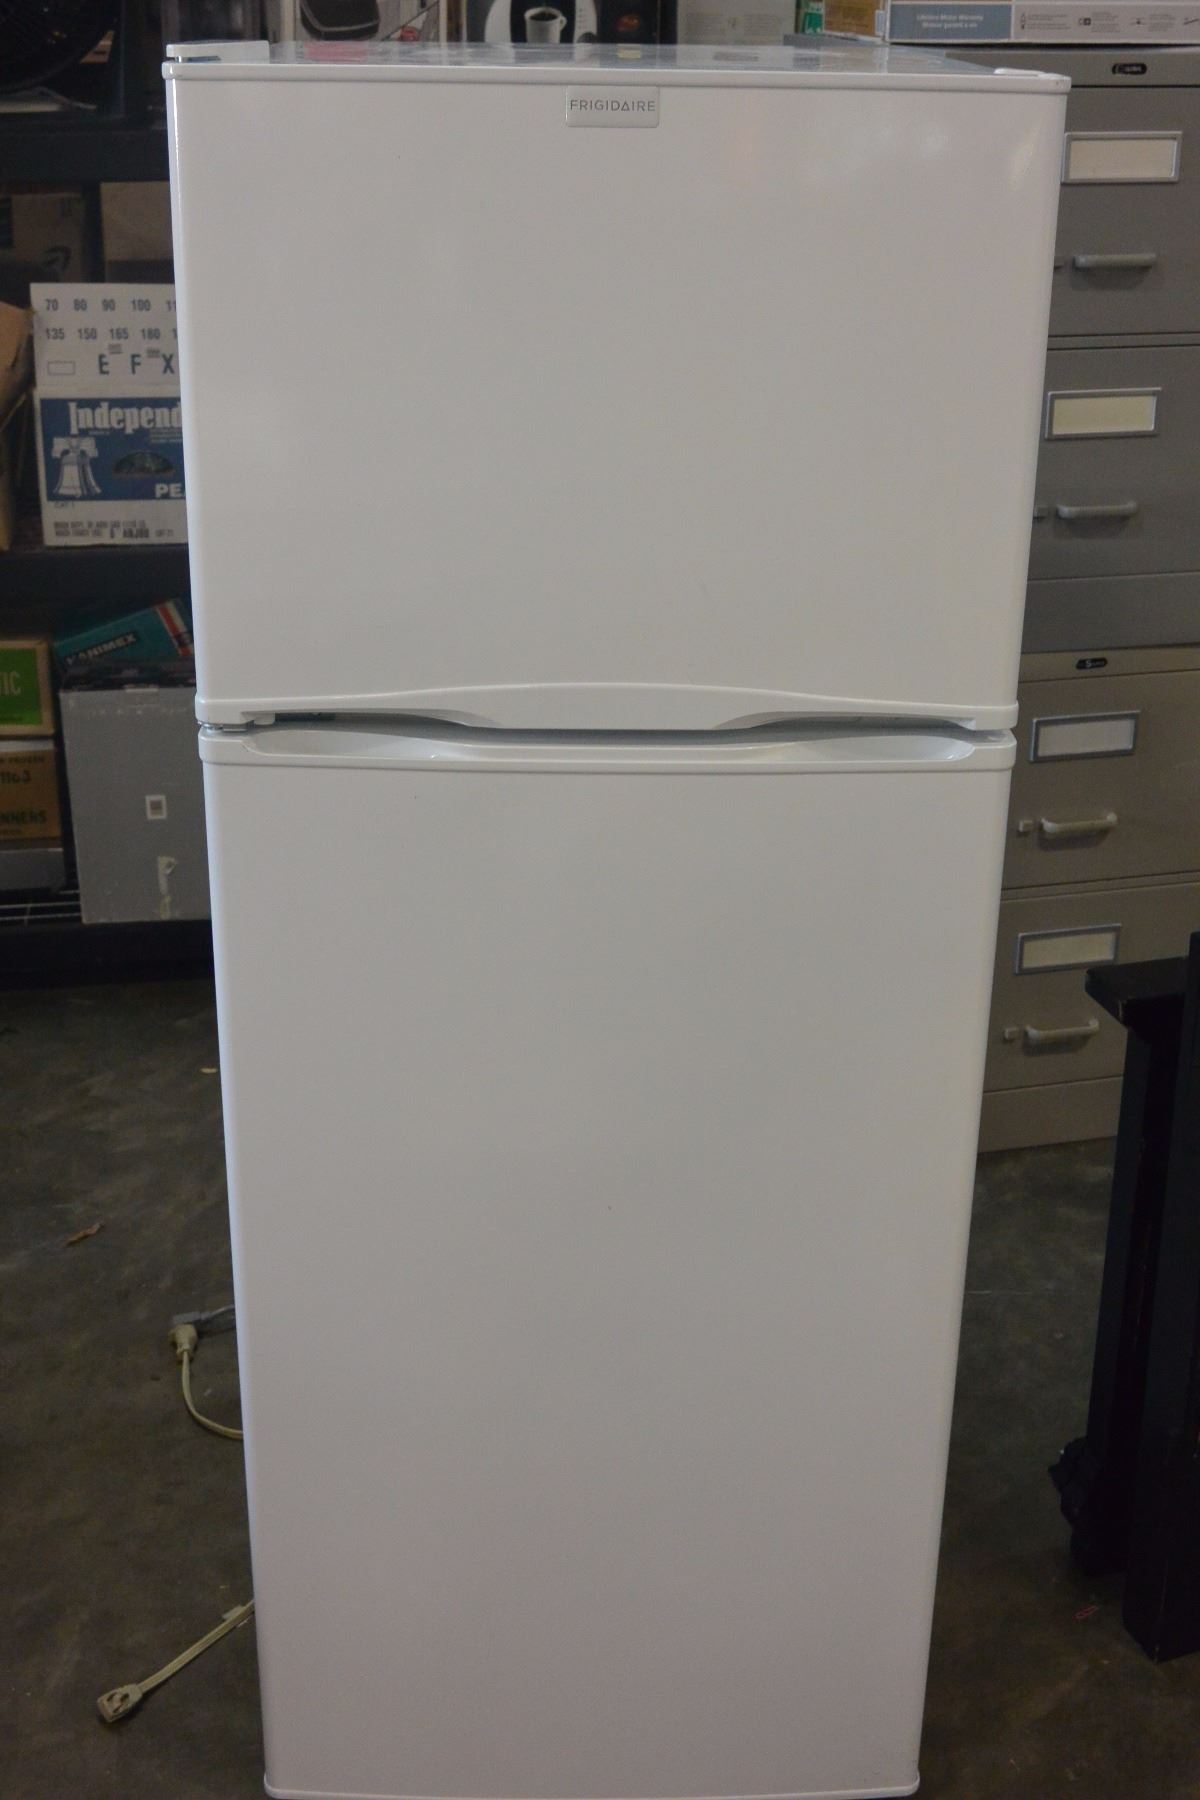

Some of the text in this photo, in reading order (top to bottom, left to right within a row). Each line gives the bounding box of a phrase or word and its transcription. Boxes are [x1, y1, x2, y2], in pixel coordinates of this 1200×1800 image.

[570, 100, 656, 112] FRIGIDAIRE
[46, 299, 58, 311] 70
[73, 299, 88, 311] 80
[102, 299, 116, 311] 90
[131, 299, 151, 311] 100
[46, 328, 65, 340] 135
[78, 328, 98, 340] 150
[109, 328, 129, 340] 165
[98, 354, 110, 375] E
[130, 354, 142, 374] F
[155, 484, 187, 498] PE
